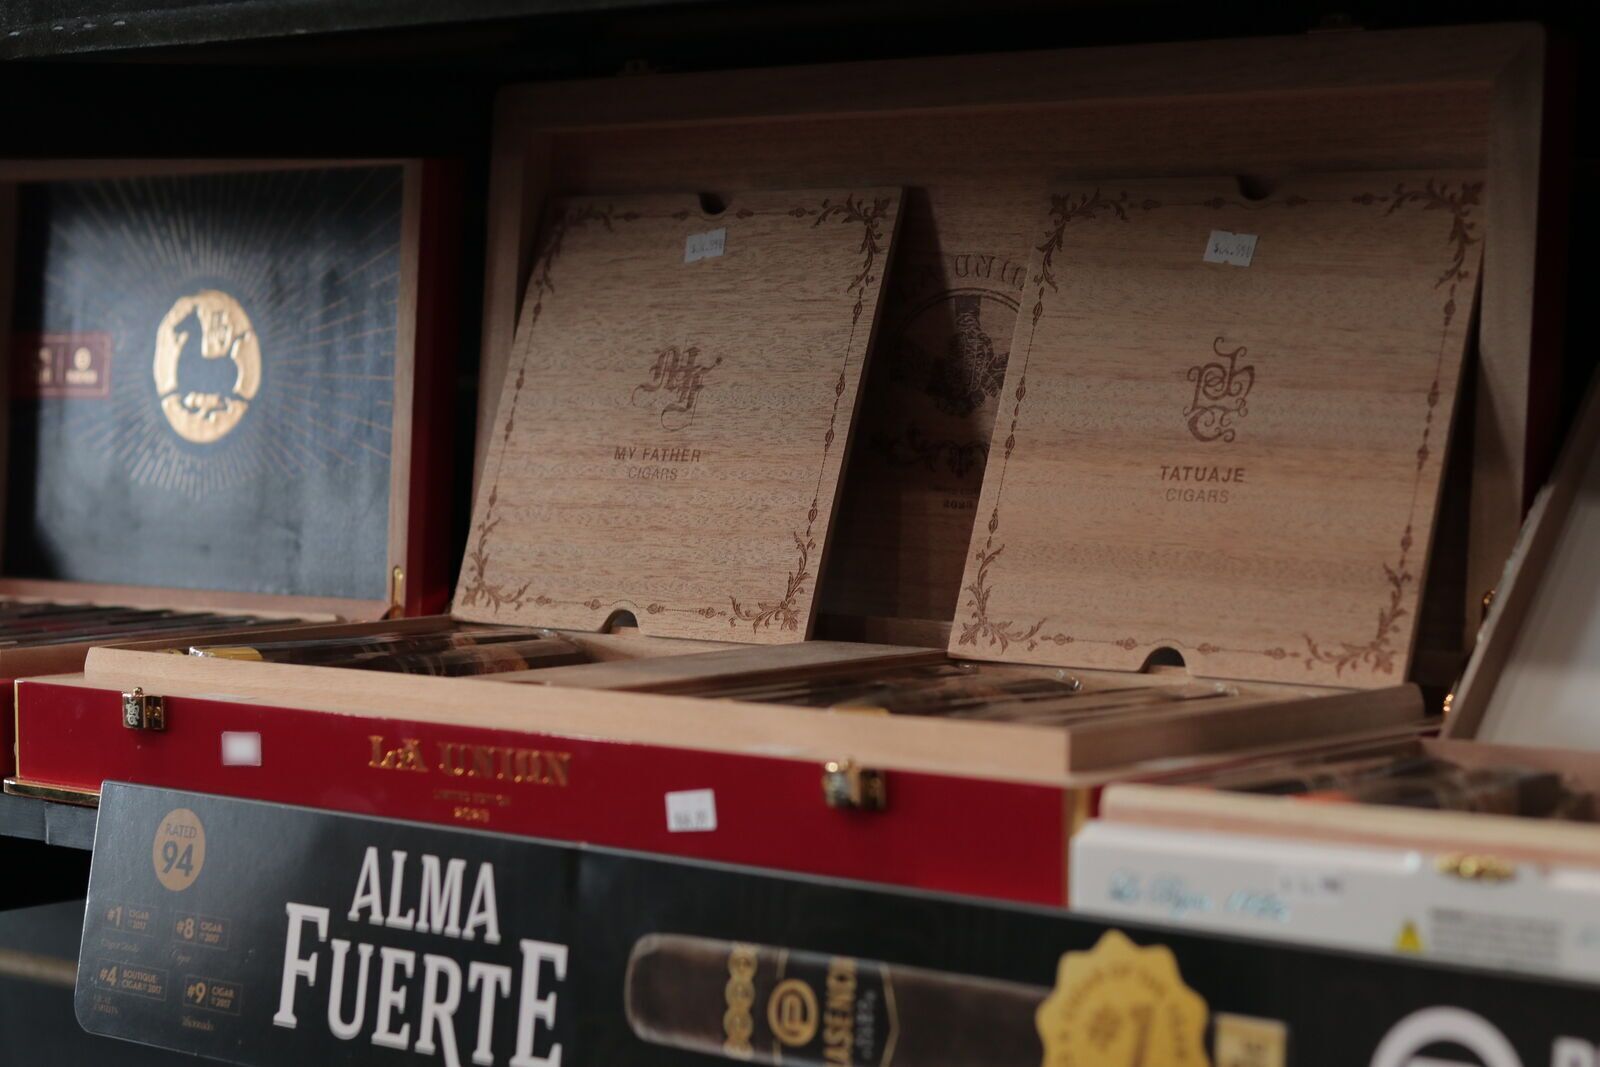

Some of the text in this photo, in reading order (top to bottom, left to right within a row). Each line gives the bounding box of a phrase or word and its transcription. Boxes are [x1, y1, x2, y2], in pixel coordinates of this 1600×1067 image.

[614, 446, 702, 462] MY FATHER
[628, 465, 678, 480] CIGARS
[1158, 464, 1245, 482] TATUAJE
[1164, 484, 1230, 500] CIGARS
[367, 735, 571, 786] LA UNION
[163, 823, 196, 838] RATED
[162, 840, 194, 878] 94
[347, 846, 502, 945] ALMA
[107, 906, 122, 927] #1
[128, 910, 149, 921] CIGAR
[176, 918, 195, 940] #8
[200, 921, 223, 933] CIGAR
[99, 965, 118, 987] #4
[273, 902, 569, 1067] FUERTE
[186, 981, 206, 1005] #9
[211, 985, 235, 998] CIGAR
